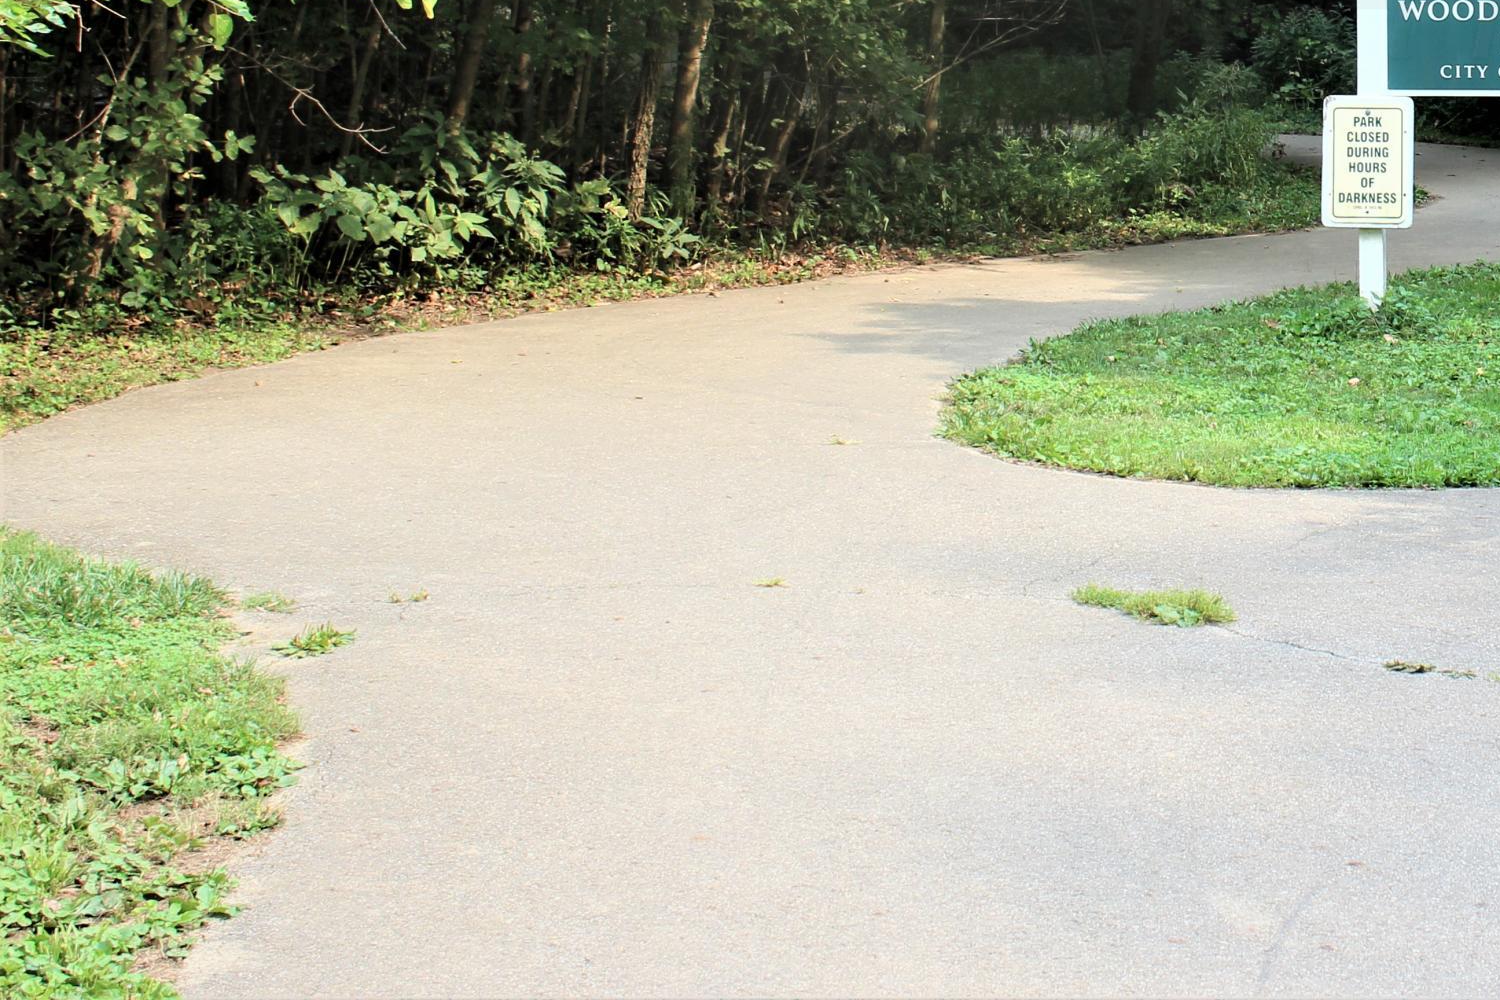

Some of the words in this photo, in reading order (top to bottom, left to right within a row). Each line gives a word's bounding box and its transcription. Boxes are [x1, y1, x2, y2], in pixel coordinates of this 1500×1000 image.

[1440, 65, 1488, 79] CITY
[1354, 117, 1382, 127] PARK
[1347, 132, 1389, 142] CLOSED
[1347, 147, 1389, 157] DURING
[1348, 162, 1387, 173] HOURS
[1360, 177, 1375, 187] OF
[1338, 193, 1396, 203] DARKNESS
